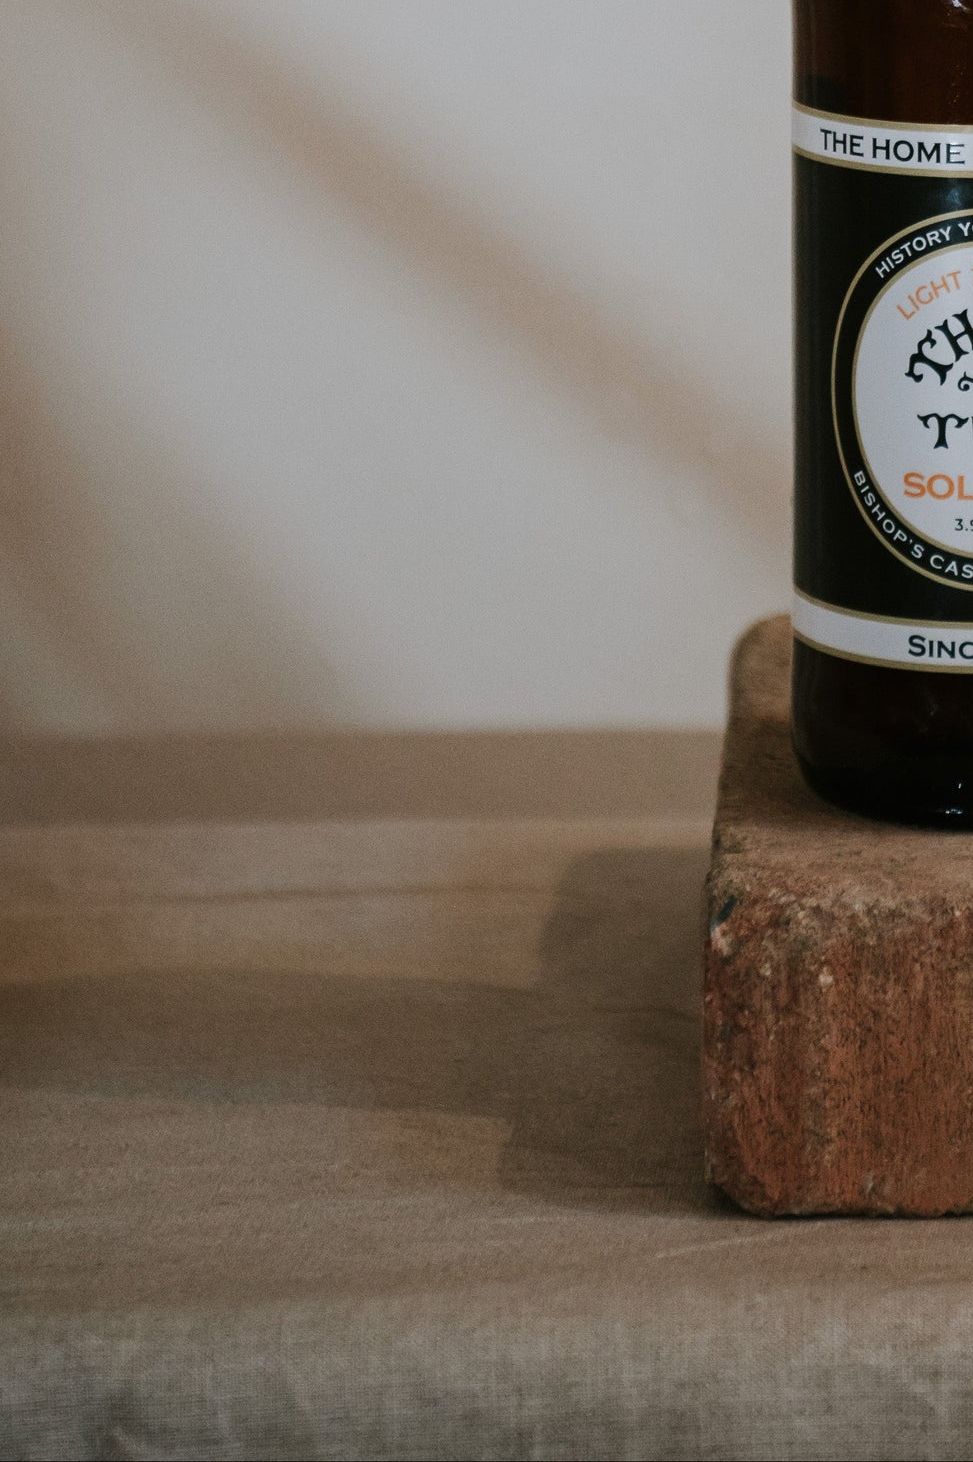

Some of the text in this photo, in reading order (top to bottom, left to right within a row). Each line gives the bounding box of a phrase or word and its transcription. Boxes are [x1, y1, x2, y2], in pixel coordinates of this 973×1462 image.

[819, 128, 864, 158] THE
[872, 139, 966, 165] HOME
[875, 226, 952, 279] HISTORY
[896, 271, 963, 320] LIGHT
[853, 470, 925, 560] BISHOP'S
